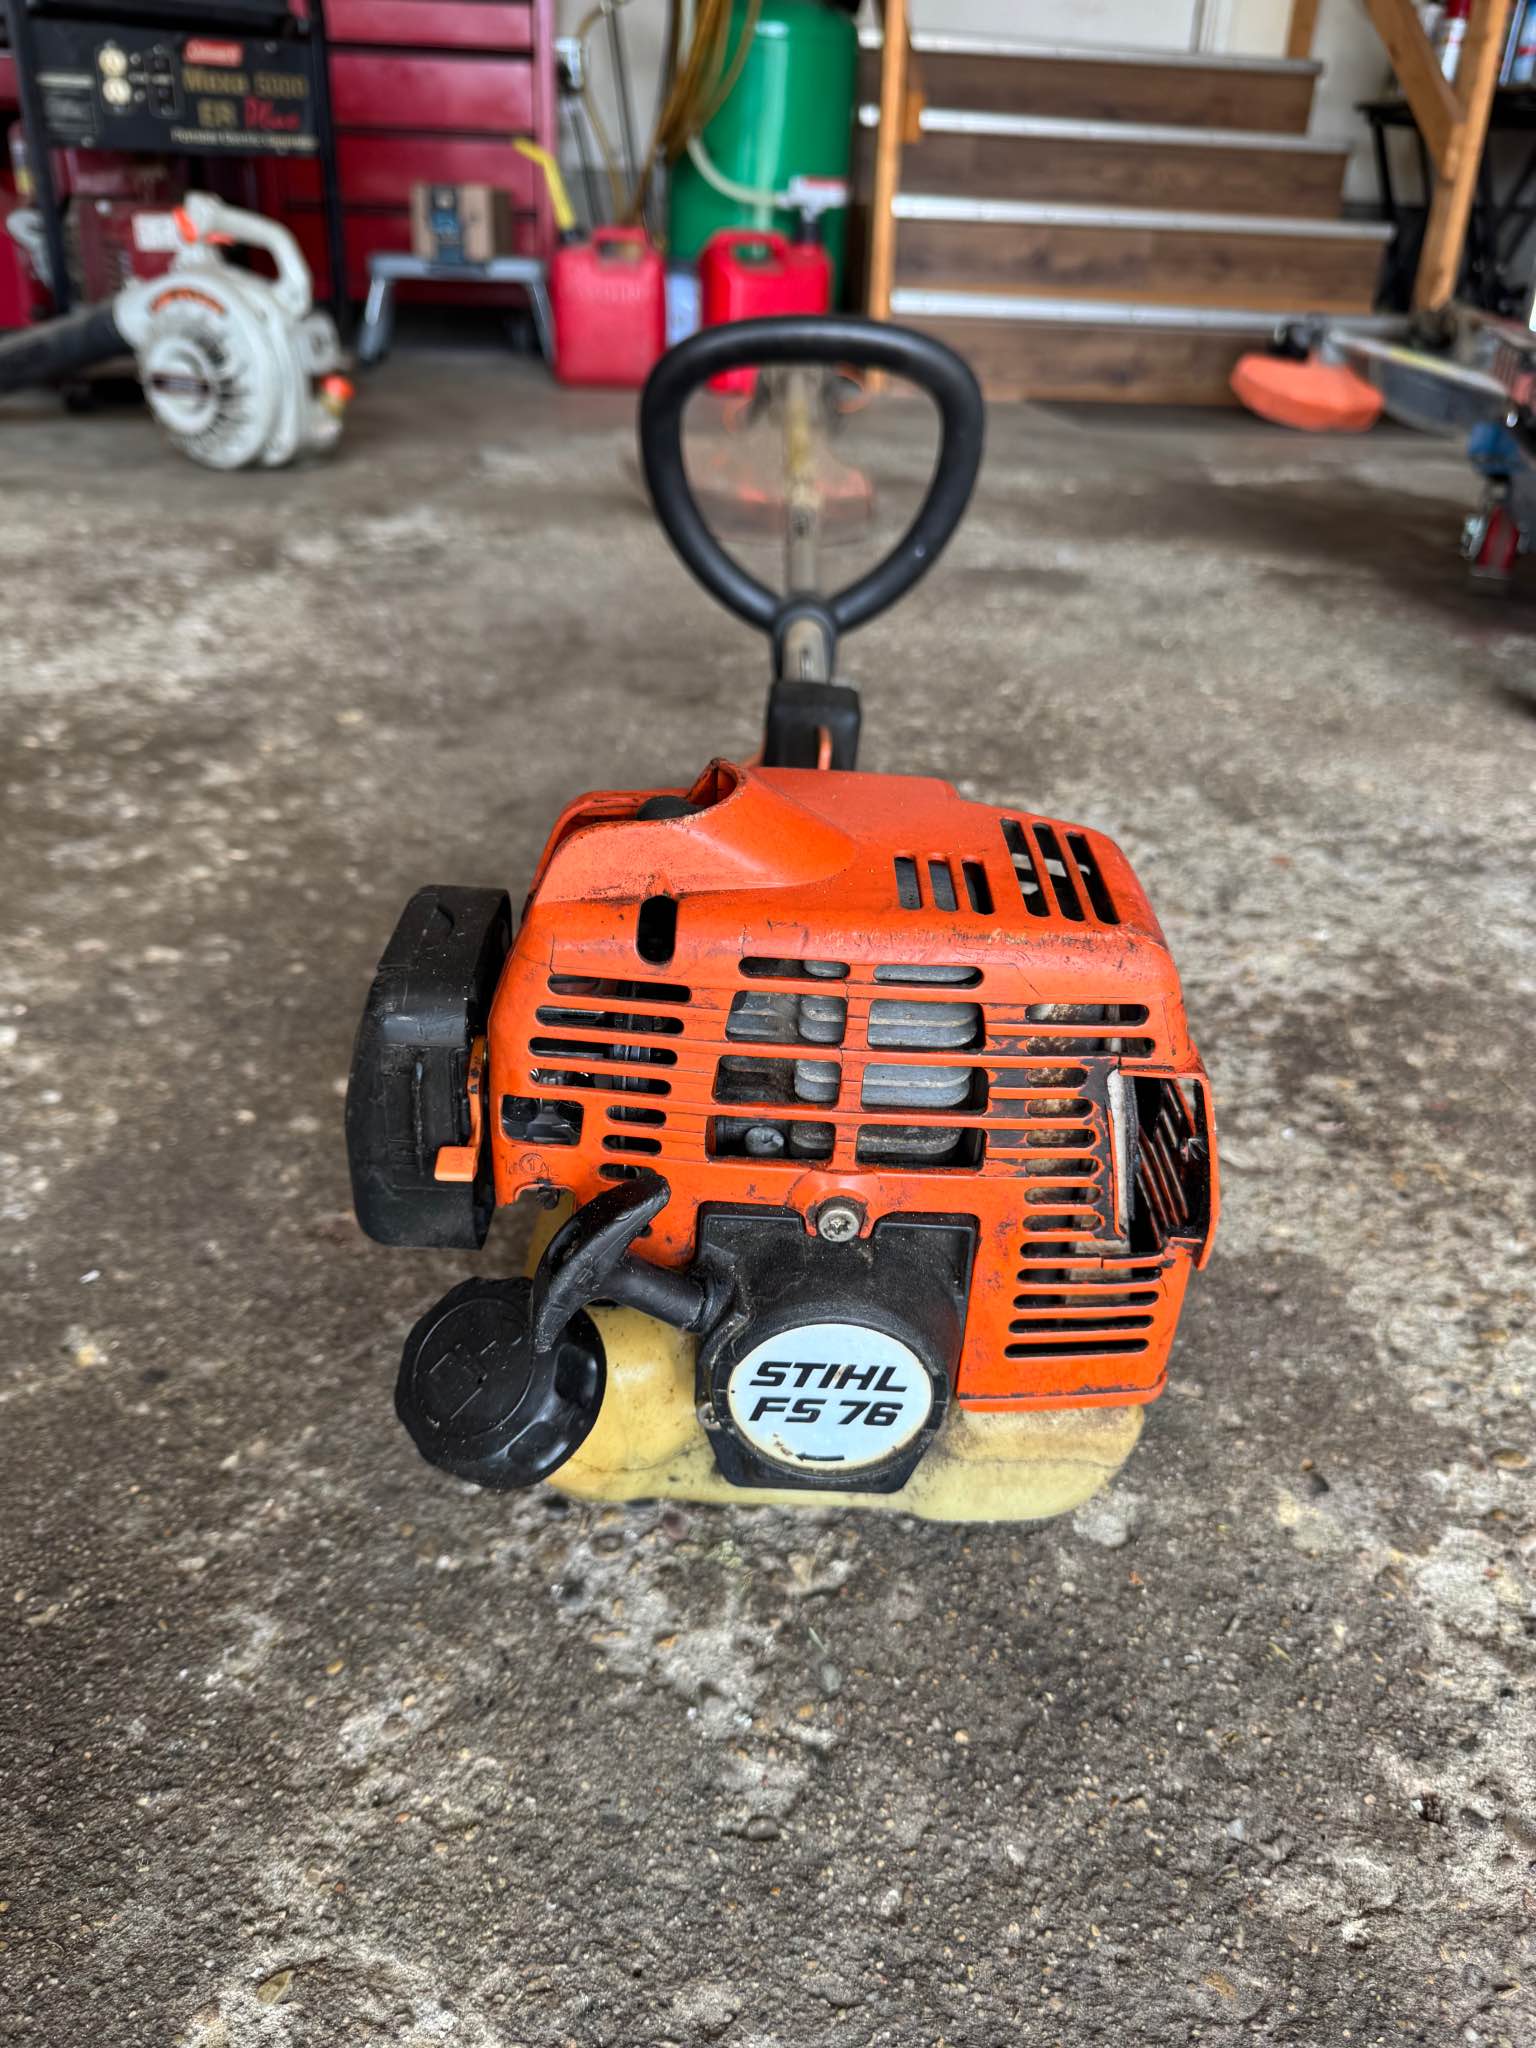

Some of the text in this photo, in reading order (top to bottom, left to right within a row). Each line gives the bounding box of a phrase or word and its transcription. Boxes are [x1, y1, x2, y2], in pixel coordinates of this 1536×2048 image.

[749, 1361, 907, 1392] STIHL
[749, 1397, 904, 1426] FS 76
